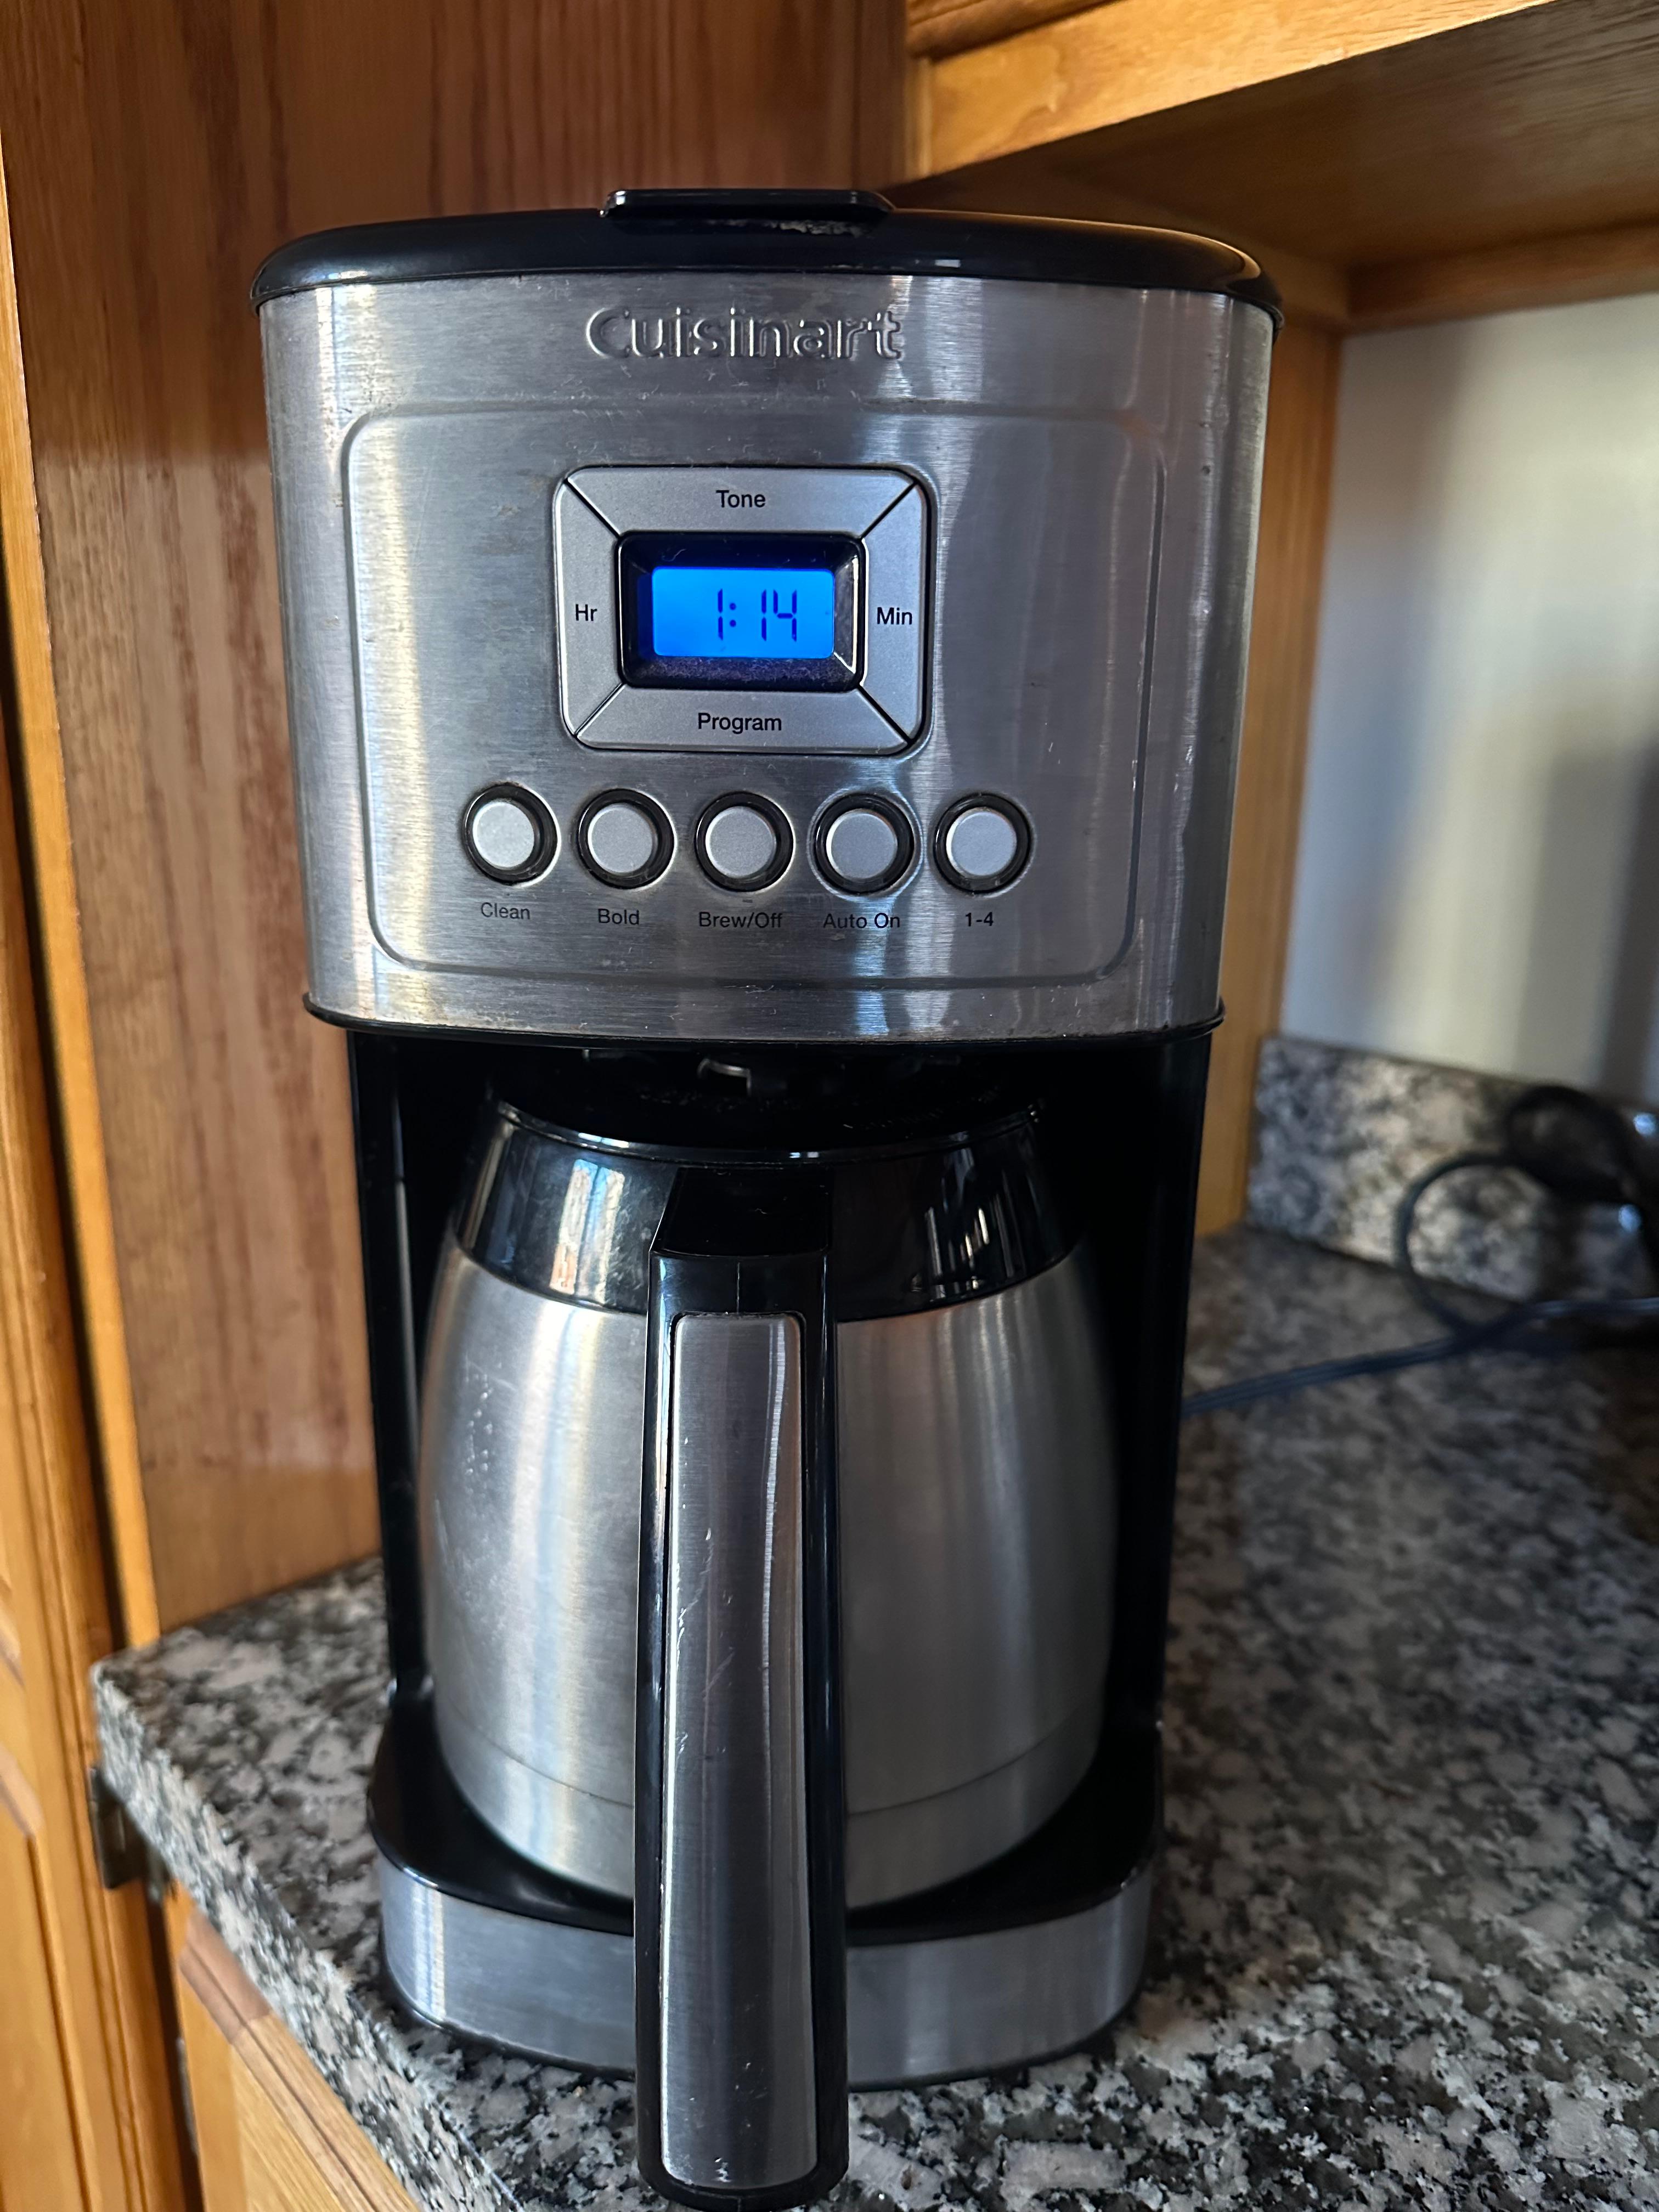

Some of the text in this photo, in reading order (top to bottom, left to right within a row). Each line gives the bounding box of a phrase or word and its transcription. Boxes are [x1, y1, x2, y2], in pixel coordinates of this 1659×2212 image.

[586, 307, 903, 359] Cuisinart
[716, 489, 766, 508] Tone
[575, 605, 597, 621] Hr
[717, 589, 797, 641] 1:14
[877, 607, 913, 625] Min
[697, 713, 782, 732] Program
[481, 902, 531, 919] Clean
[598, 908, 640, 925] Bold
[699, 911, 783, 928] Brew/Off
[823, 912, 900, 929] Auto On
[965, 912, 994, 927] 1-4
